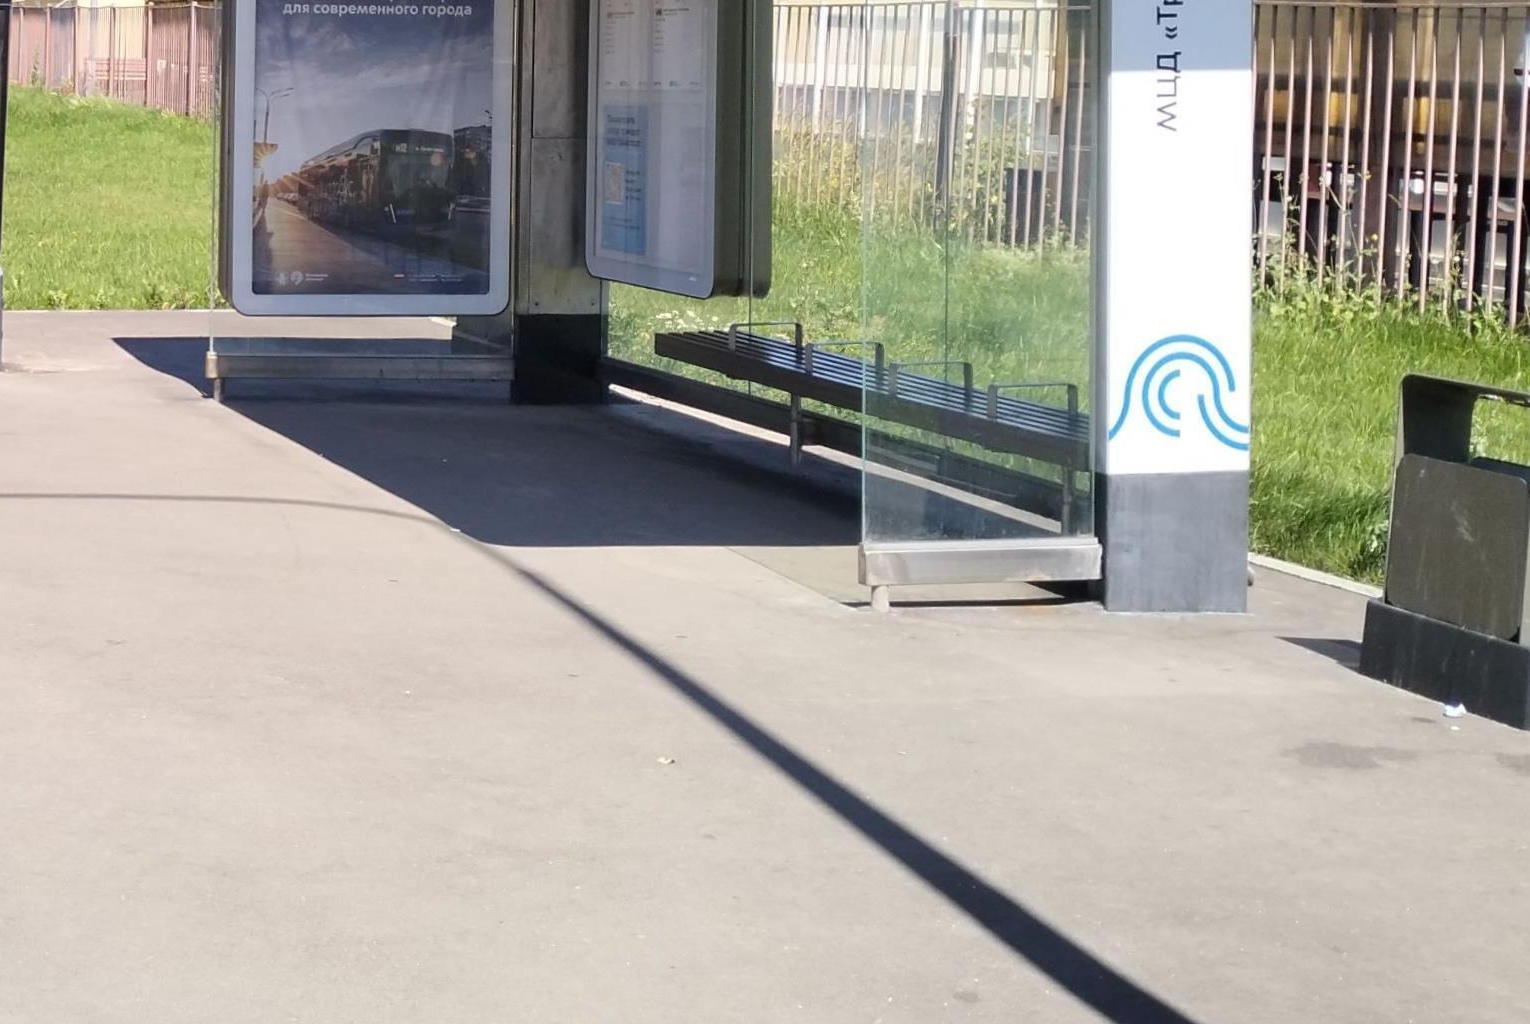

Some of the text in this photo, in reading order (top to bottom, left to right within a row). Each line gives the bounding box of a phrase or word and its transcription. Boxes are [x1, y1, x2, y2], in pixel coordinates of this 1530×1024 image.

[282, 2, 472, 18] для современного города
[1156, 51, 1182, 132] МЦД
